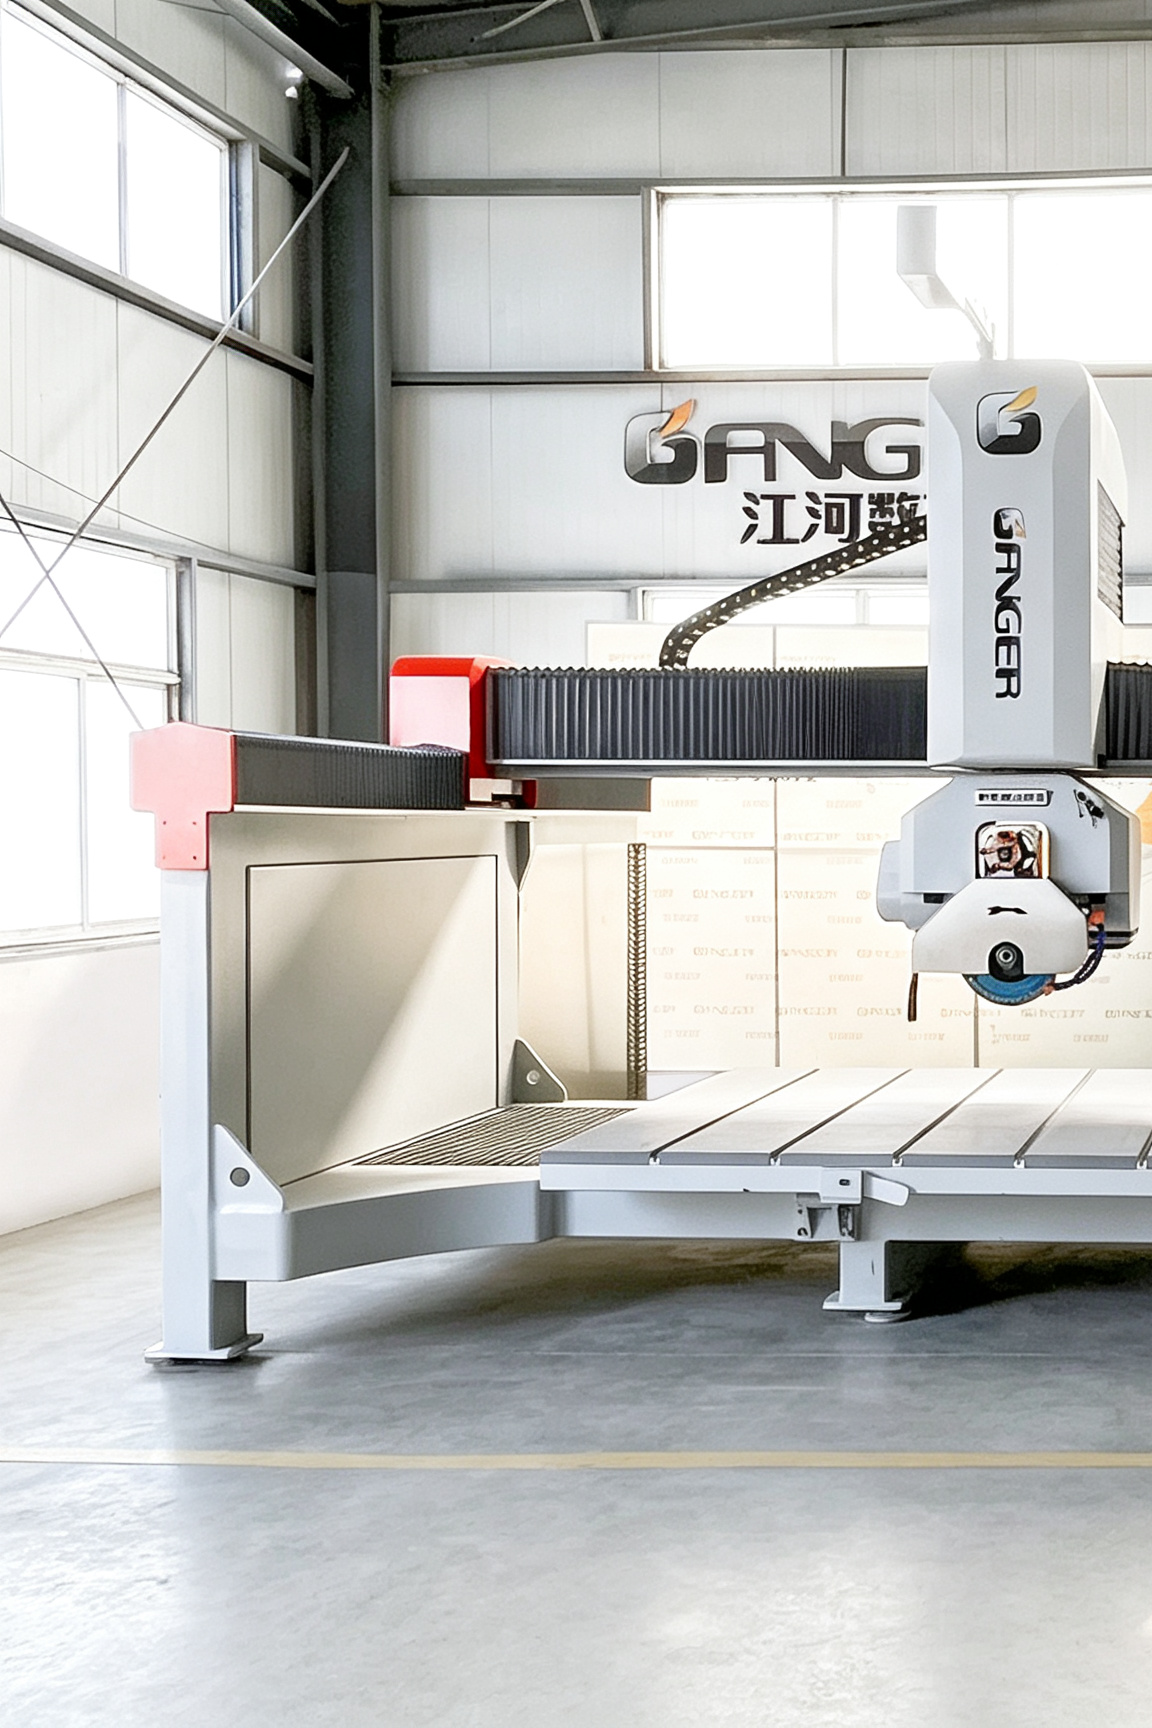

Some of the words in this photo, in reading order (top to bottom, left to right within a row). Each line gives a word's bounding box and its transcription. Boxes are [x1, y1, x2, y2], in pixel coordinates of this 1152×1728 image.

[740, 491, 928, 544] 江河数
[993, 507, 1027, 699] GANGER
